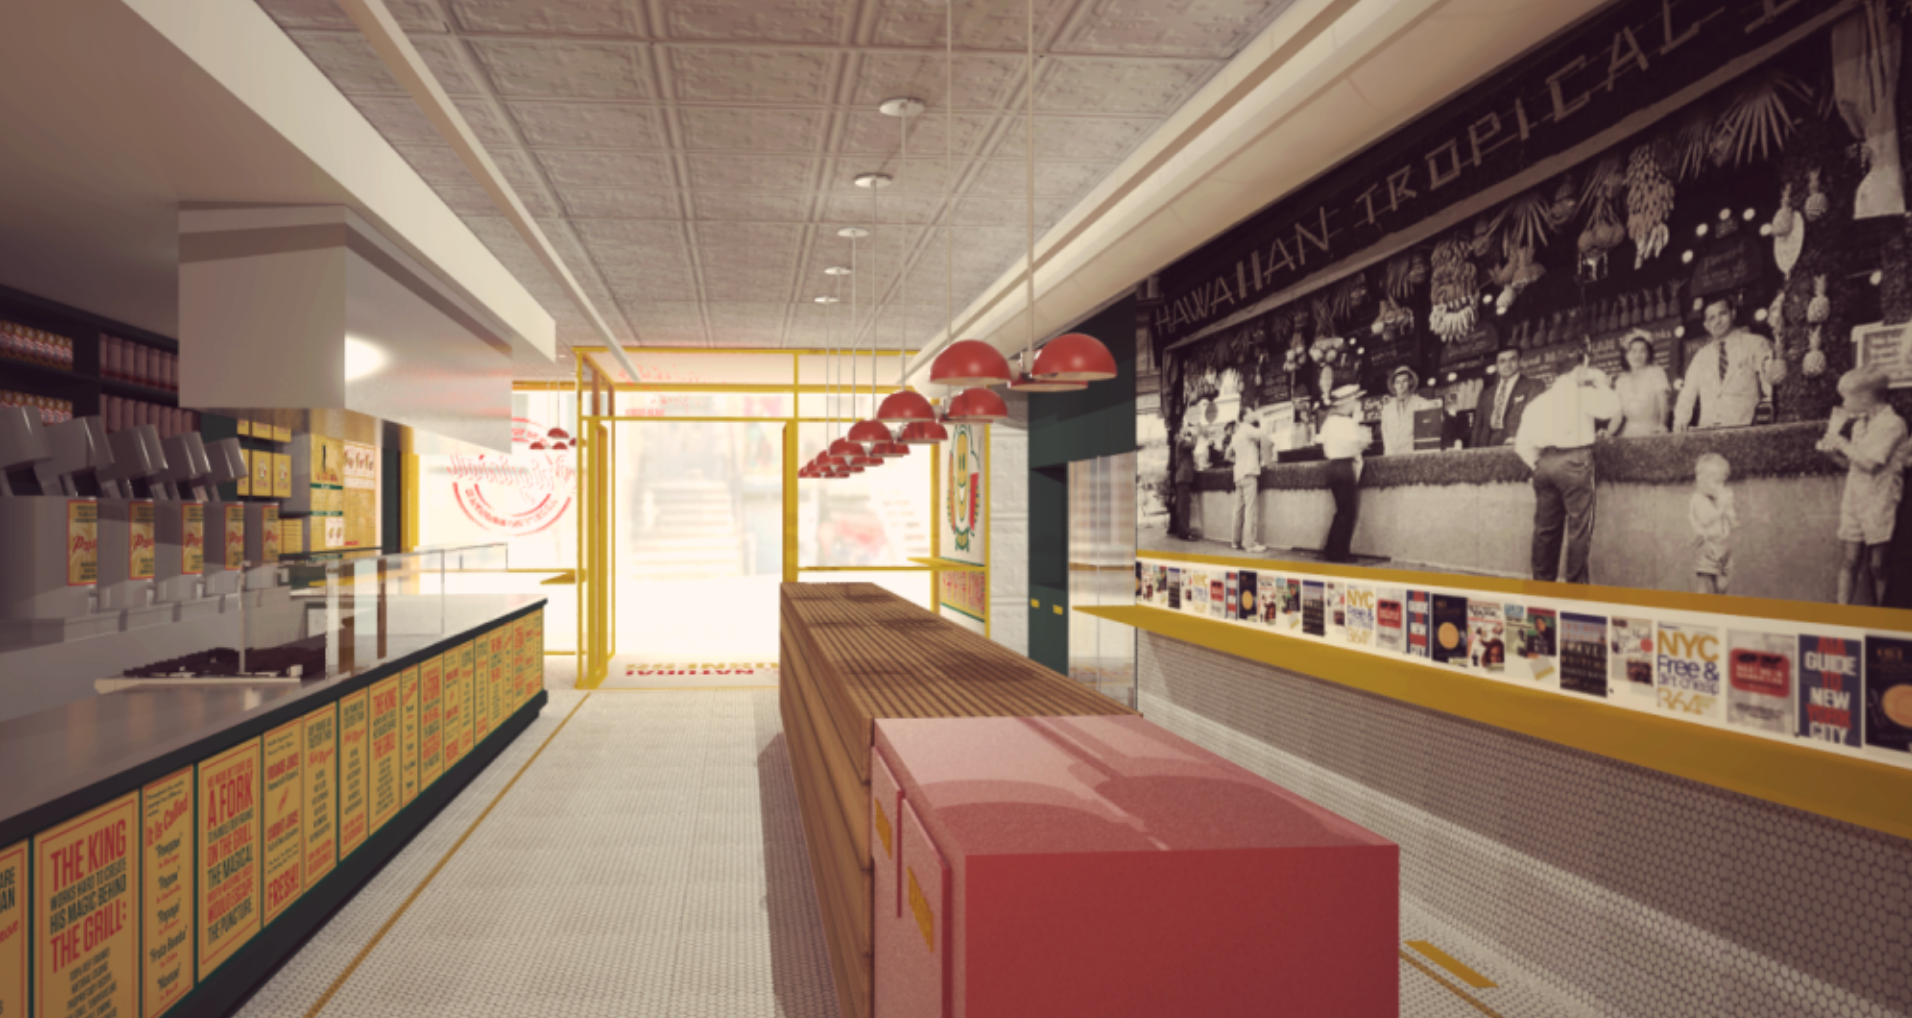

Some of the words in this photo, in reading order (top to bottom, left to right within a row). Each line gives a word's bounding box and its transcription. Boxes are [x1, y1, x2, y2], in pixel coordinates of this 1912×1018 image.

[1155, 206, 1329, 336] HAWAIIAN
[1354, 0, 1700, 225] TROPICAL
[1658, 630, 1719, 662] NYC
[1658, 654, 1700, 679] Free
[1703, 661, 1720, 681] &
[1804, 651, 1857, 677] GUIDE
[1821, 670, 1842, 692] TO
[1810, 687, 1850, 712] NEW
[1806, 703, 1852, 730] YORK
[207, 788, 217, 831] A
[219, 769, 253, 824] FORK
[50, 839, 84, 893] THE
[88, 818, 126, 873] KING
[0, 885, 15, 914] AN
[50, 884, 76, 912] WORKS
[50, 907, 66, 935] HIS
[67, 890, 96, 925] MAGIC
[98, 873, 126, 907] BEHIND
[50, 922, 80, 974] THE
[83, 899, 126, 953] GRILL:
